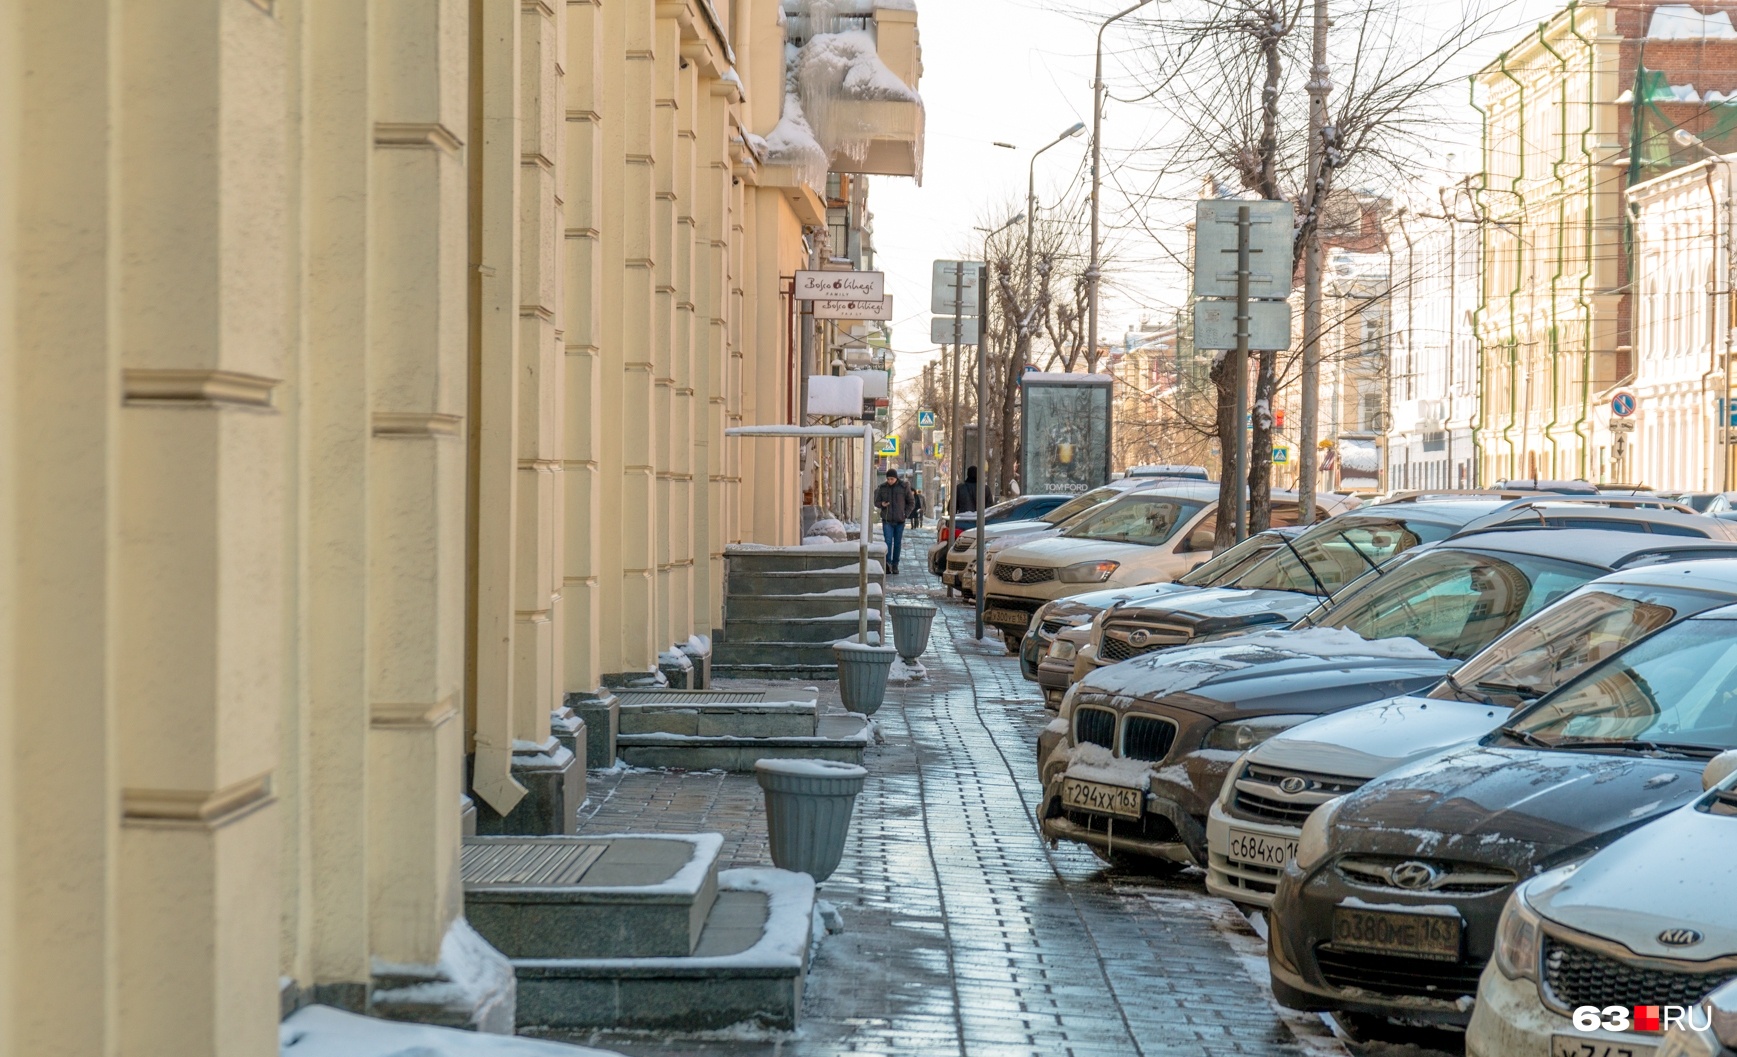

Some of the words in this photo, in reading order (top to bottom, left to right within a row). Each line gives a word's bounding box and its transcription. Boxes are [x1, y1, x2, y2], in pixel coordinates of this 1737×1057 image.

[804, 277, 831, 291] Bosco
[1044, 483, 1063, 491] TOM
[1064, 483, 1089, 491] FORD
[1117, 790, 1138, 808] 163
[1421, 919, 1452, 941] 163
[1661, 929, 1694, 943] KIA
